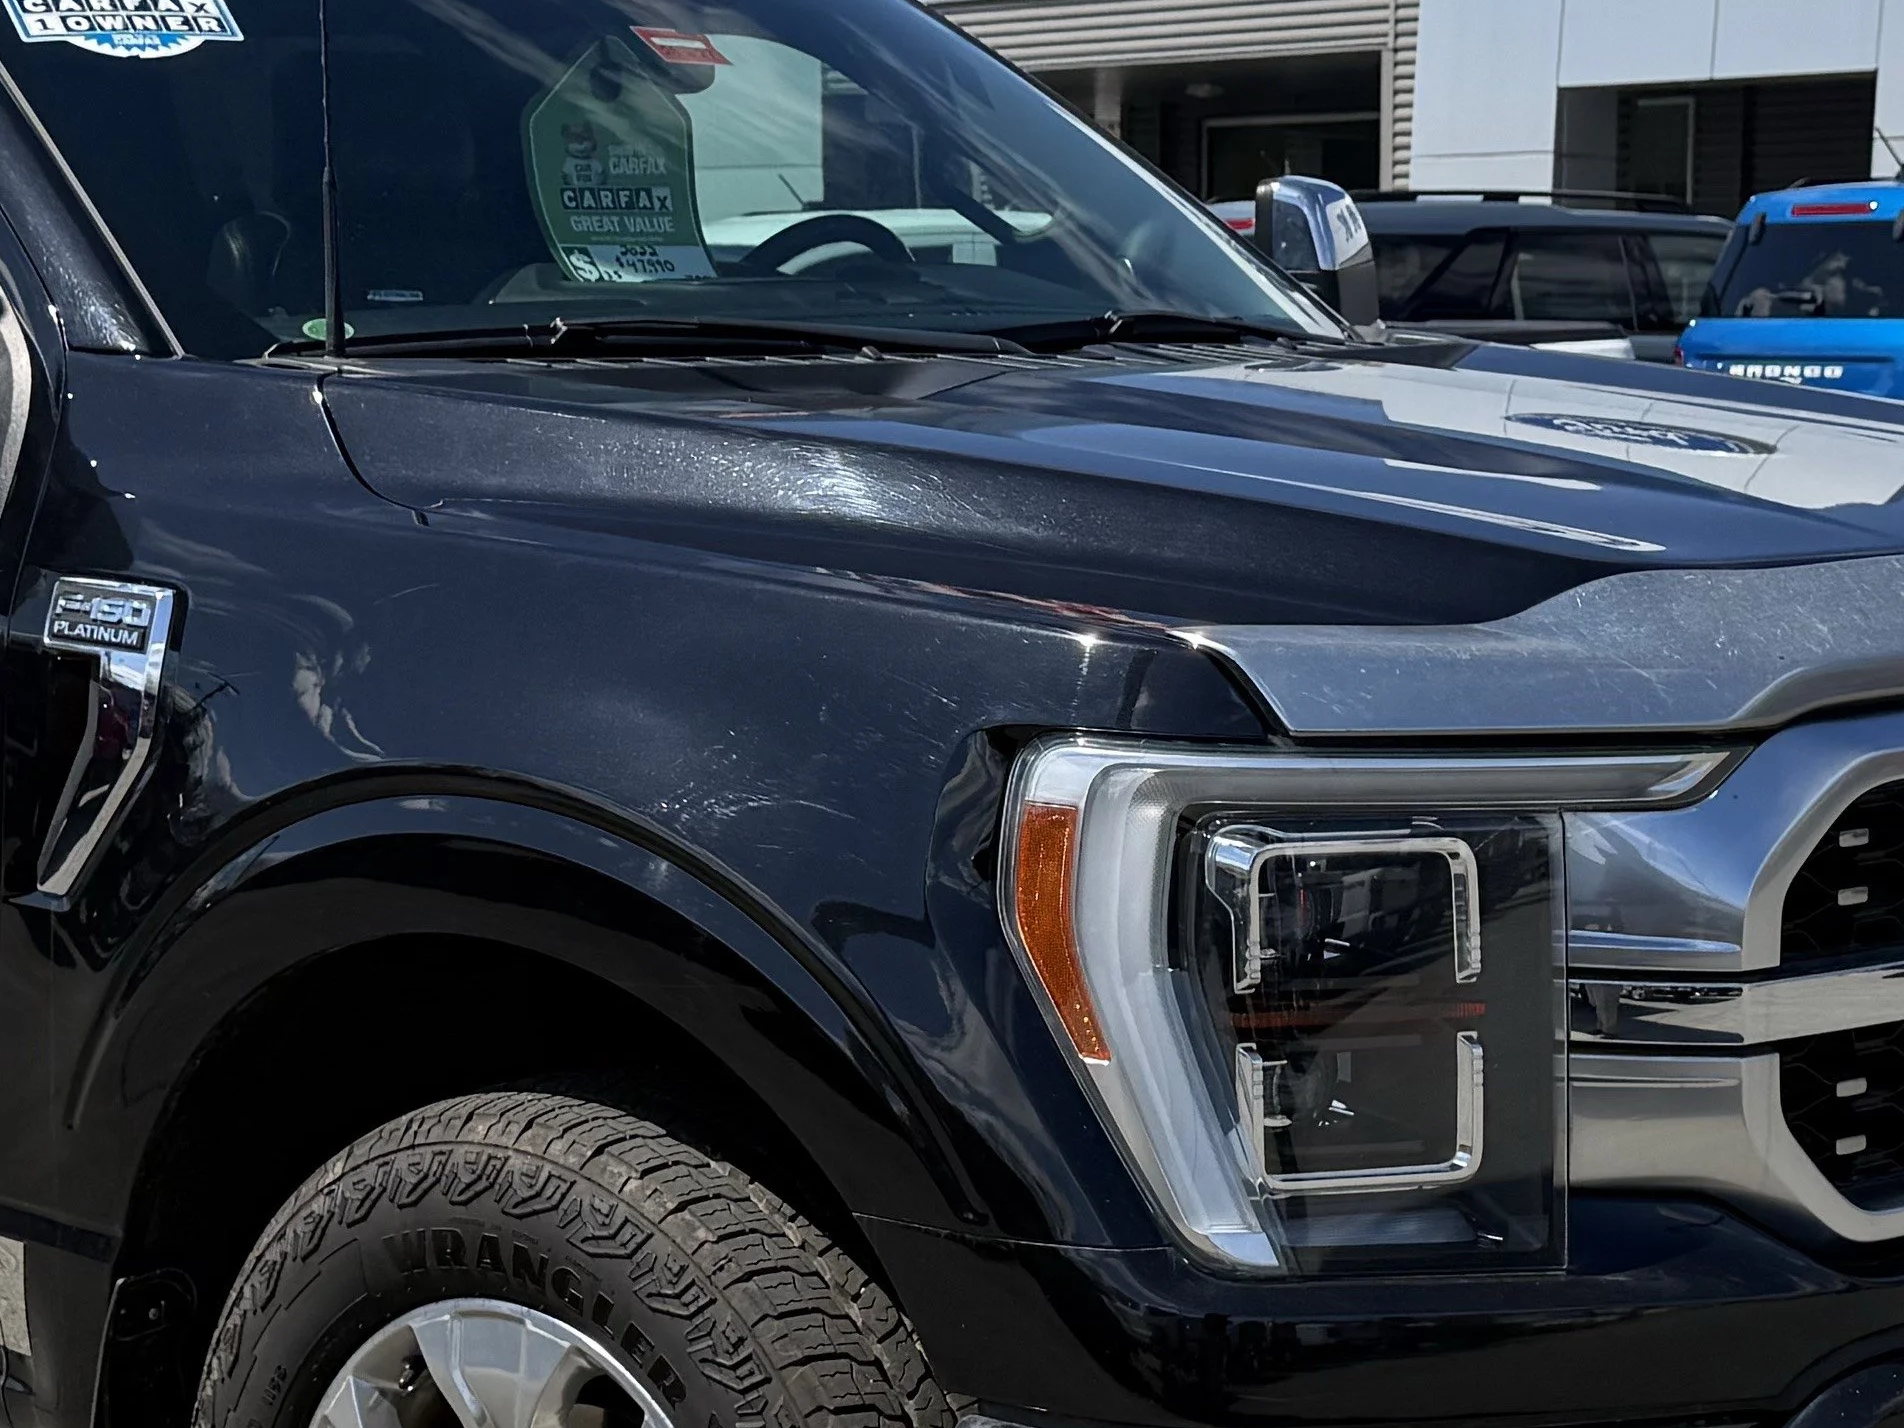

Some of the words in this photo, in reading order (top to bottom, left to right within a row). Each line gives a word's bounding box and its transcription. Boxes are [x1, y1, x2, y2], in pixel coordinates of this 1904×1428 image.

[30, 18, 55, 31] 1
[64, 15, 222, 32] OWNER
[608, 156, 667, 174] CARFAX
[562, 189, 671, 211] CARFAX
[570, 215, 621, 232] GREAT
[624, 215, 676, 232] VALUE
[53, 620, 140, 647] PLATINUM
[380, 1226, 688, 1412] WRANGLER
